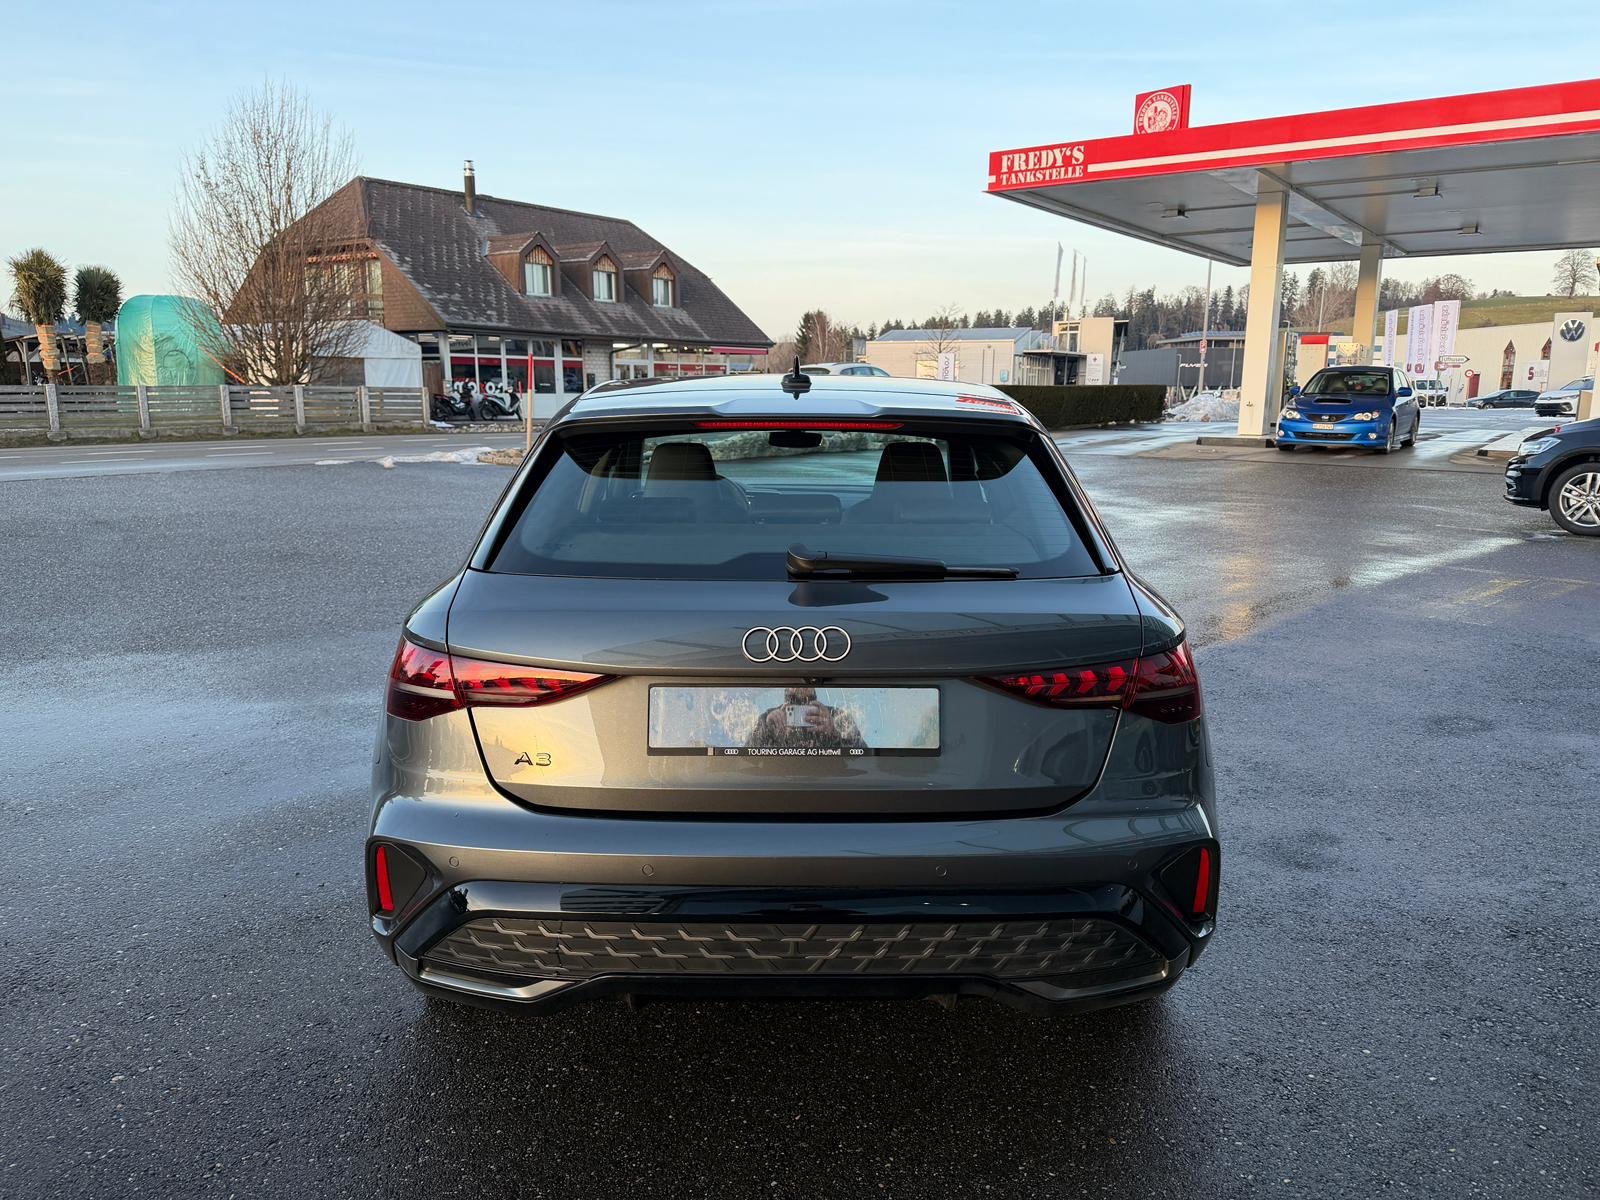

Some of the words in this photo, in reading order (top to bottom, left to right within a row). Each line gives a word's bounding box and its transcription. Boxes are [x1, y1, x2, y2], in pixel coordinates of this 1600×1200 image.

[1000, 165, 1084, 186] TANKSTELLE
[513, 751, 552, 767] A3
[747, 748, 778, 756] TOURING
[778, 748, 806, 756] GARAGE
[806, 748, 818, 756] AG
[818, 748, 841, 756] Huttwil
